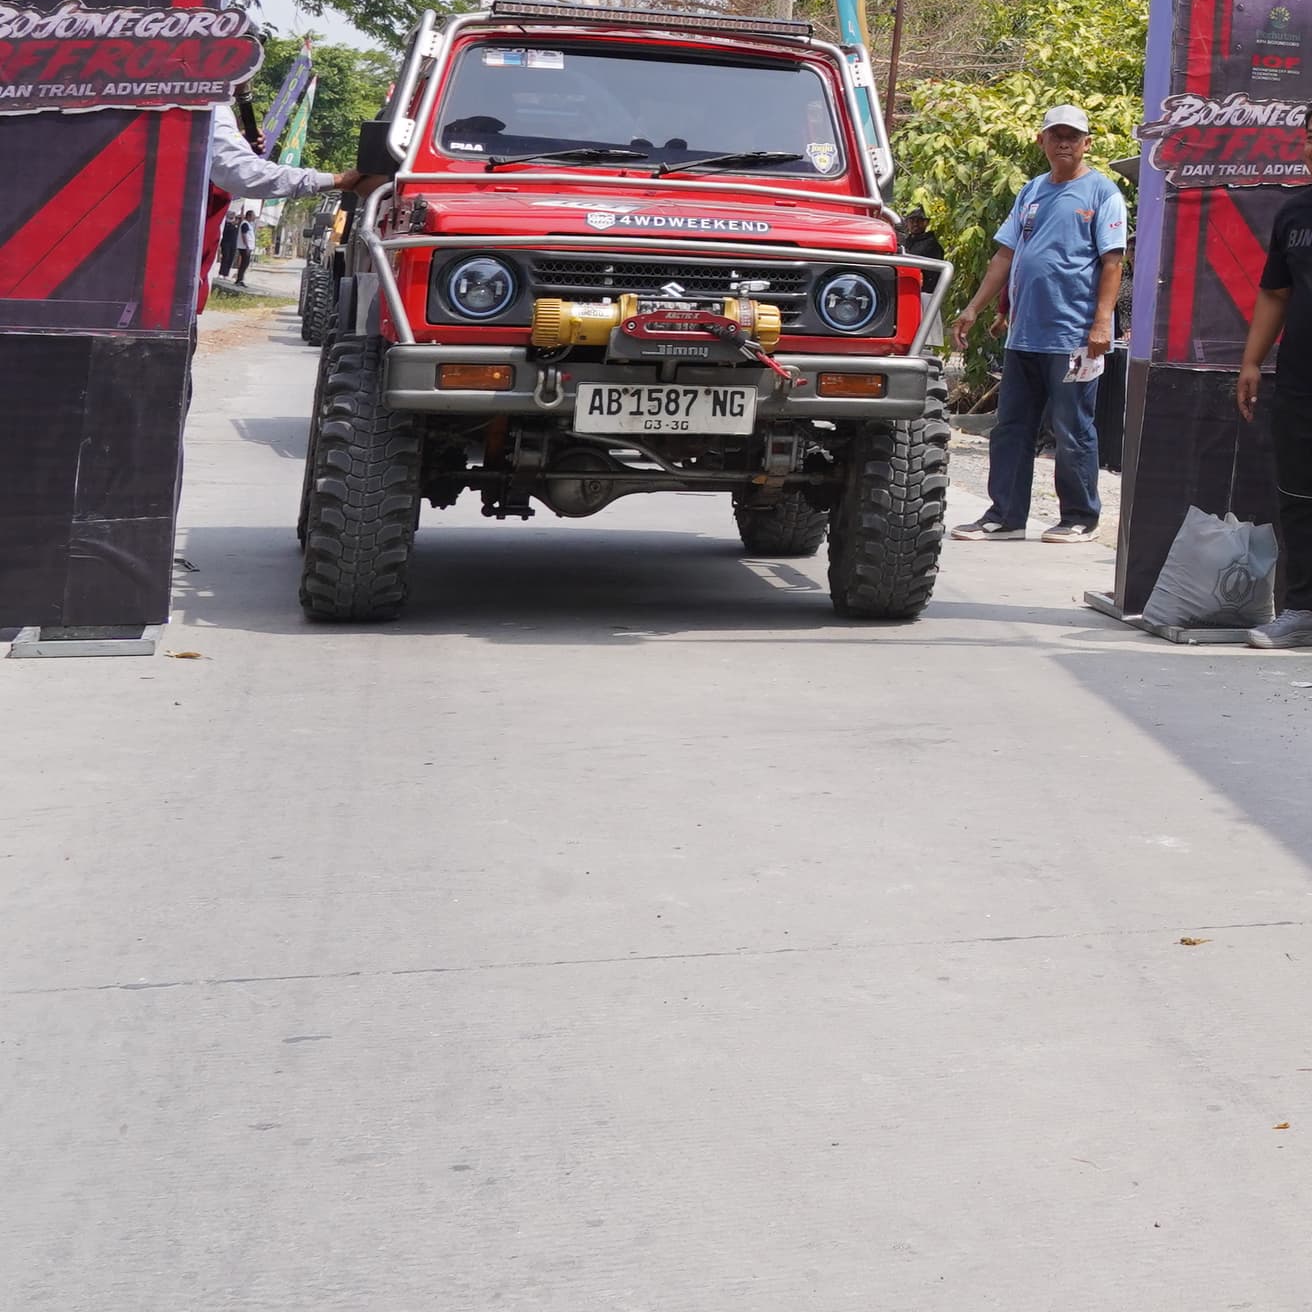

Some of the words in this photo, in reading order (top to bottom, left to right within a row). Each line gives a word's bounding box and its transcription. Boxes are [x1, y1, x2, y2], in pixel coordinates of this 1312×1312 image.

[1252, 54, 1302, 69] IOF
[38, 83, 96, 97] TRAIL
[102, 80, 225, 95] ADVENTURE
[1168, 96, 1307, 128] BOJONEG
[450, 142, 484, 152] PIAA
[1160, 127, 1307, 161] OFFRO
[1181, 164, 1215, 177] DAN
[1218, 164, 1259, 176] TRAIL
[1263, 163, 1312, 175] ADVEN
[619, 215, 770, 233] 4WDWEEKEND
[642, 344, 710, 358] Jimny
[588, 387, 623, 416] AB
[628, 388, 698, 417] 1587
[711, 390, 746, 417] NG
